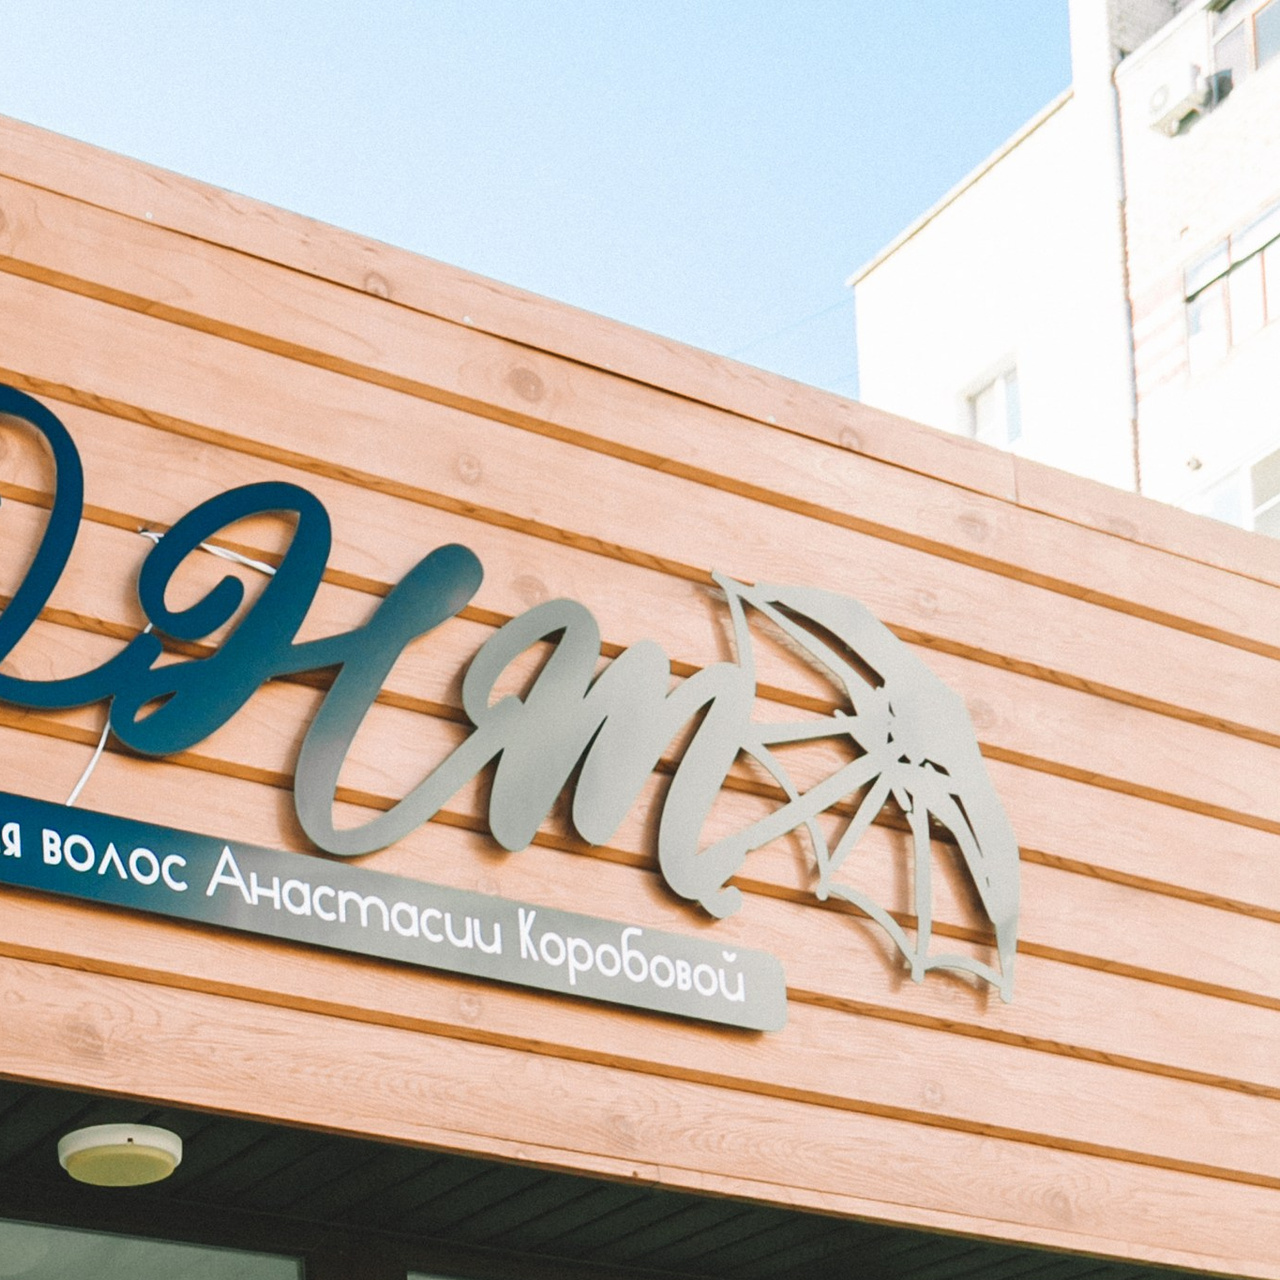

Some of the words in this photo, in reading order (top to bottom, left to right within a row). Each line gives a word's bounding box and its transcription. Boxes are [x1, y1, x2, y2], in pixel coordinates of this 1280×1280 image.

[42, 828, 188, 892] волос
[205, 845, 502, 955] Анастасии
[517, 907, 746, 1002] Коробовой
